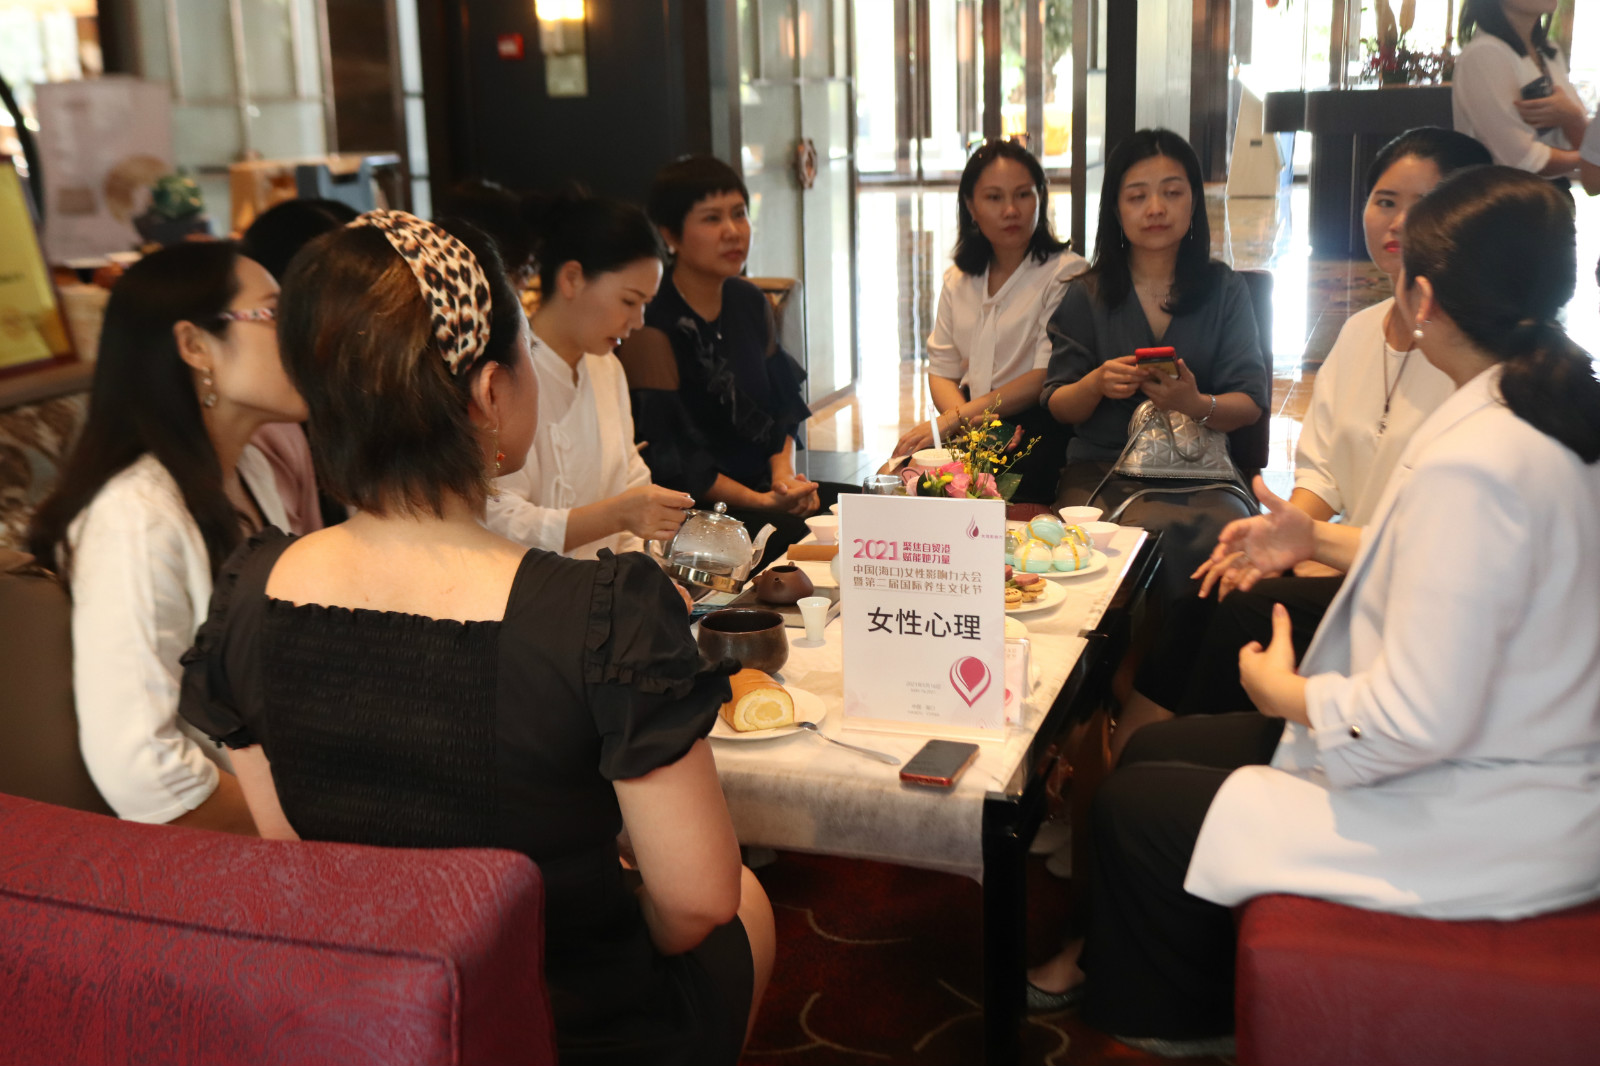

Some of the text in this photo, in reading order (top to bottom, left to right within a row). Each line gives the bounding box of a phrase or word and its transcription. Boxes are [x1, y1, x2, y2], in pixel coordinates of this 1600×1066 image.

[853, 538, 899, 561] 2021
[903, 541, 951, 554] 聚焦自贸港
[902, 553, 951, 564] 赋能她力量
[853, 576, 983, 595] 暨第二届国际养生文化节
[867, 607, 982, 641] 女性心理
